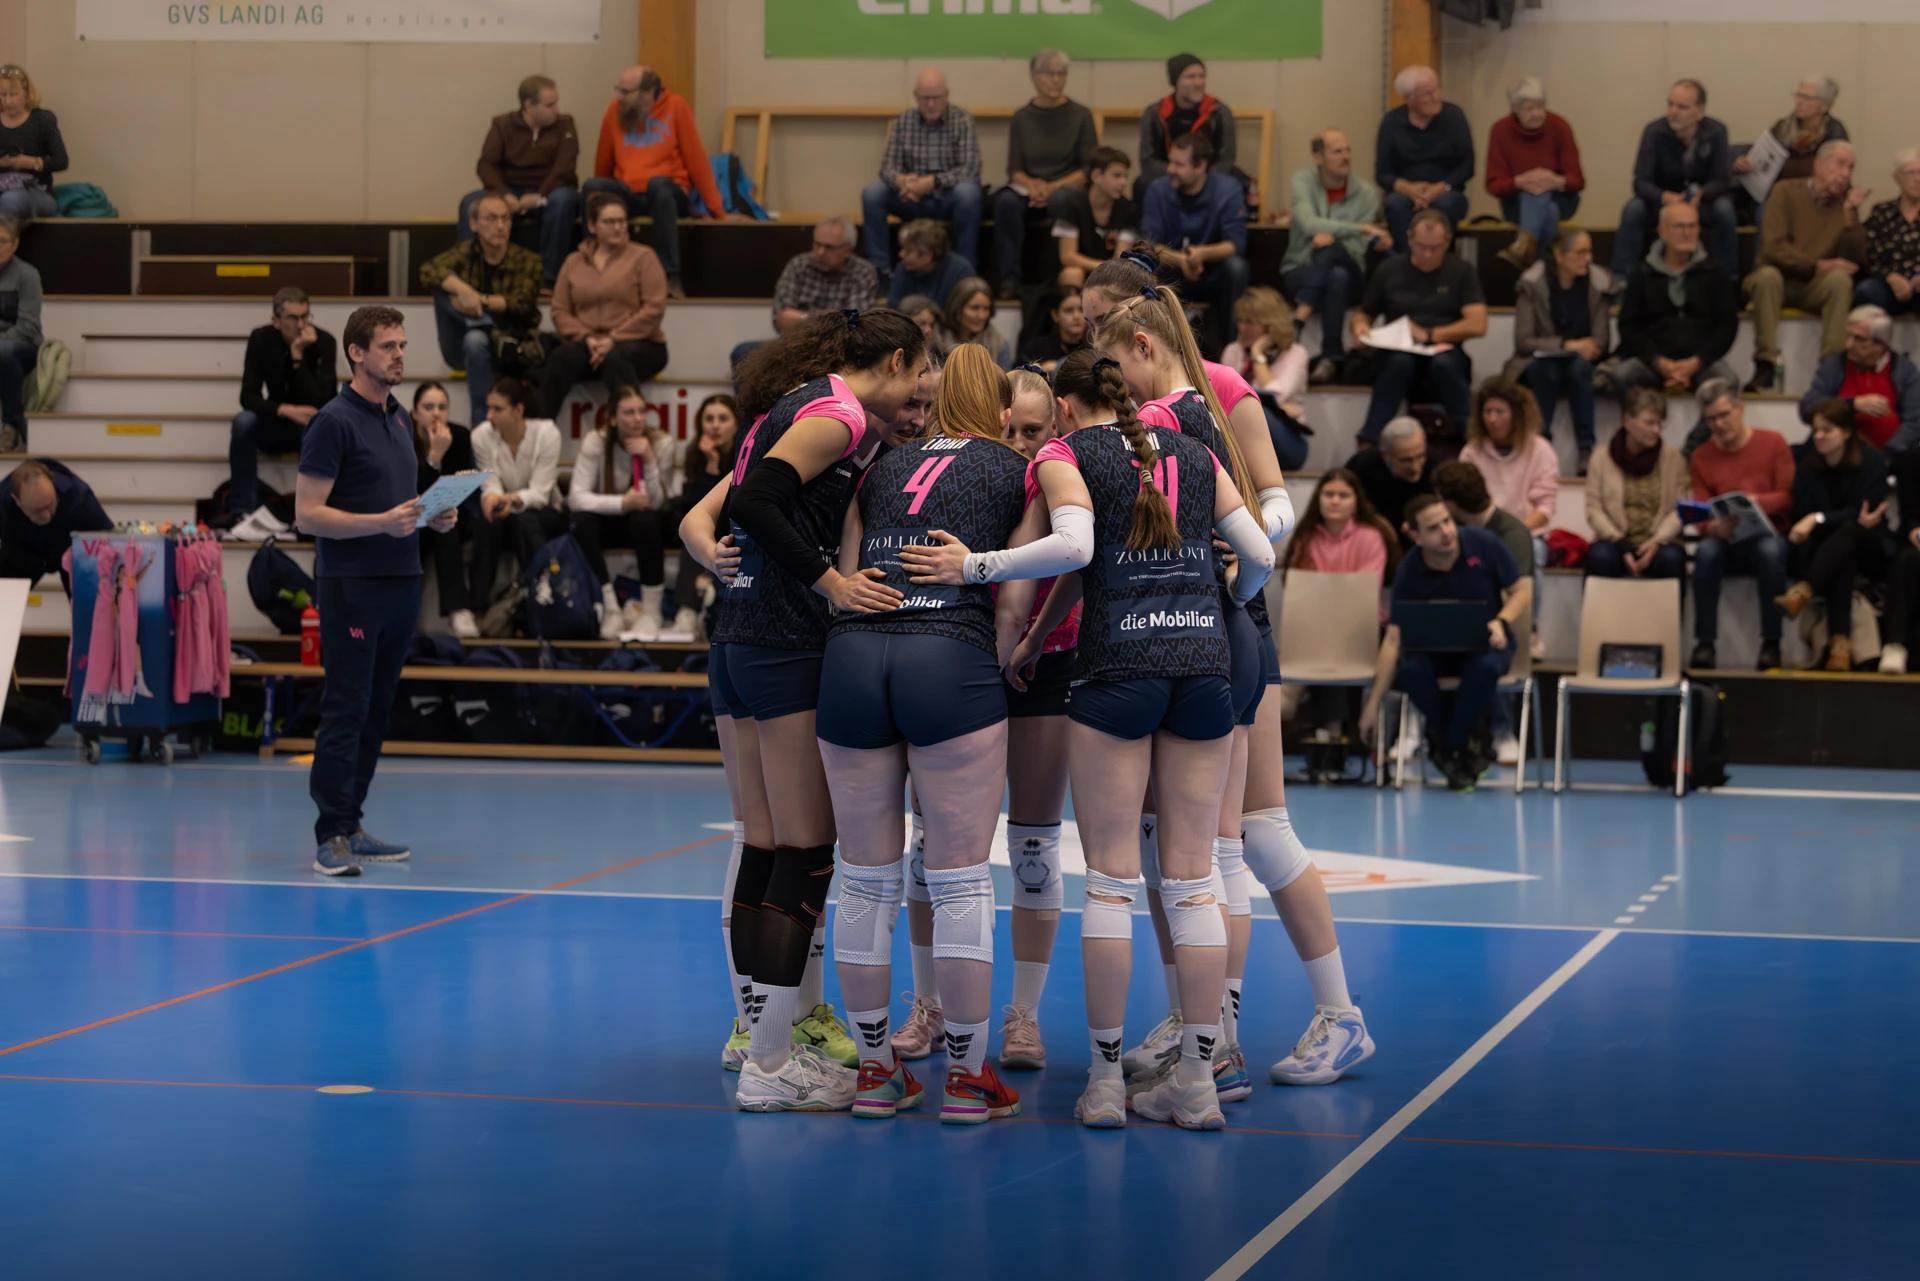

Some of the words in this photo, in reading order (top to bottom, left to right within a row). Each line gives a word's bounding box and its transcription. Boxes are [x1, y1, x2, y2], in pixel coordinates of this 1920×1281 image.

[168, 5, 210, 25] GVS
[219, 5, 285, 25] LANDI
[294, 5, 324, 25] AG
[902, 455, 957, 515] 4
[1120, 613, 1147, 631] die
[1149, 610, 1215, 628] Mobiliar
